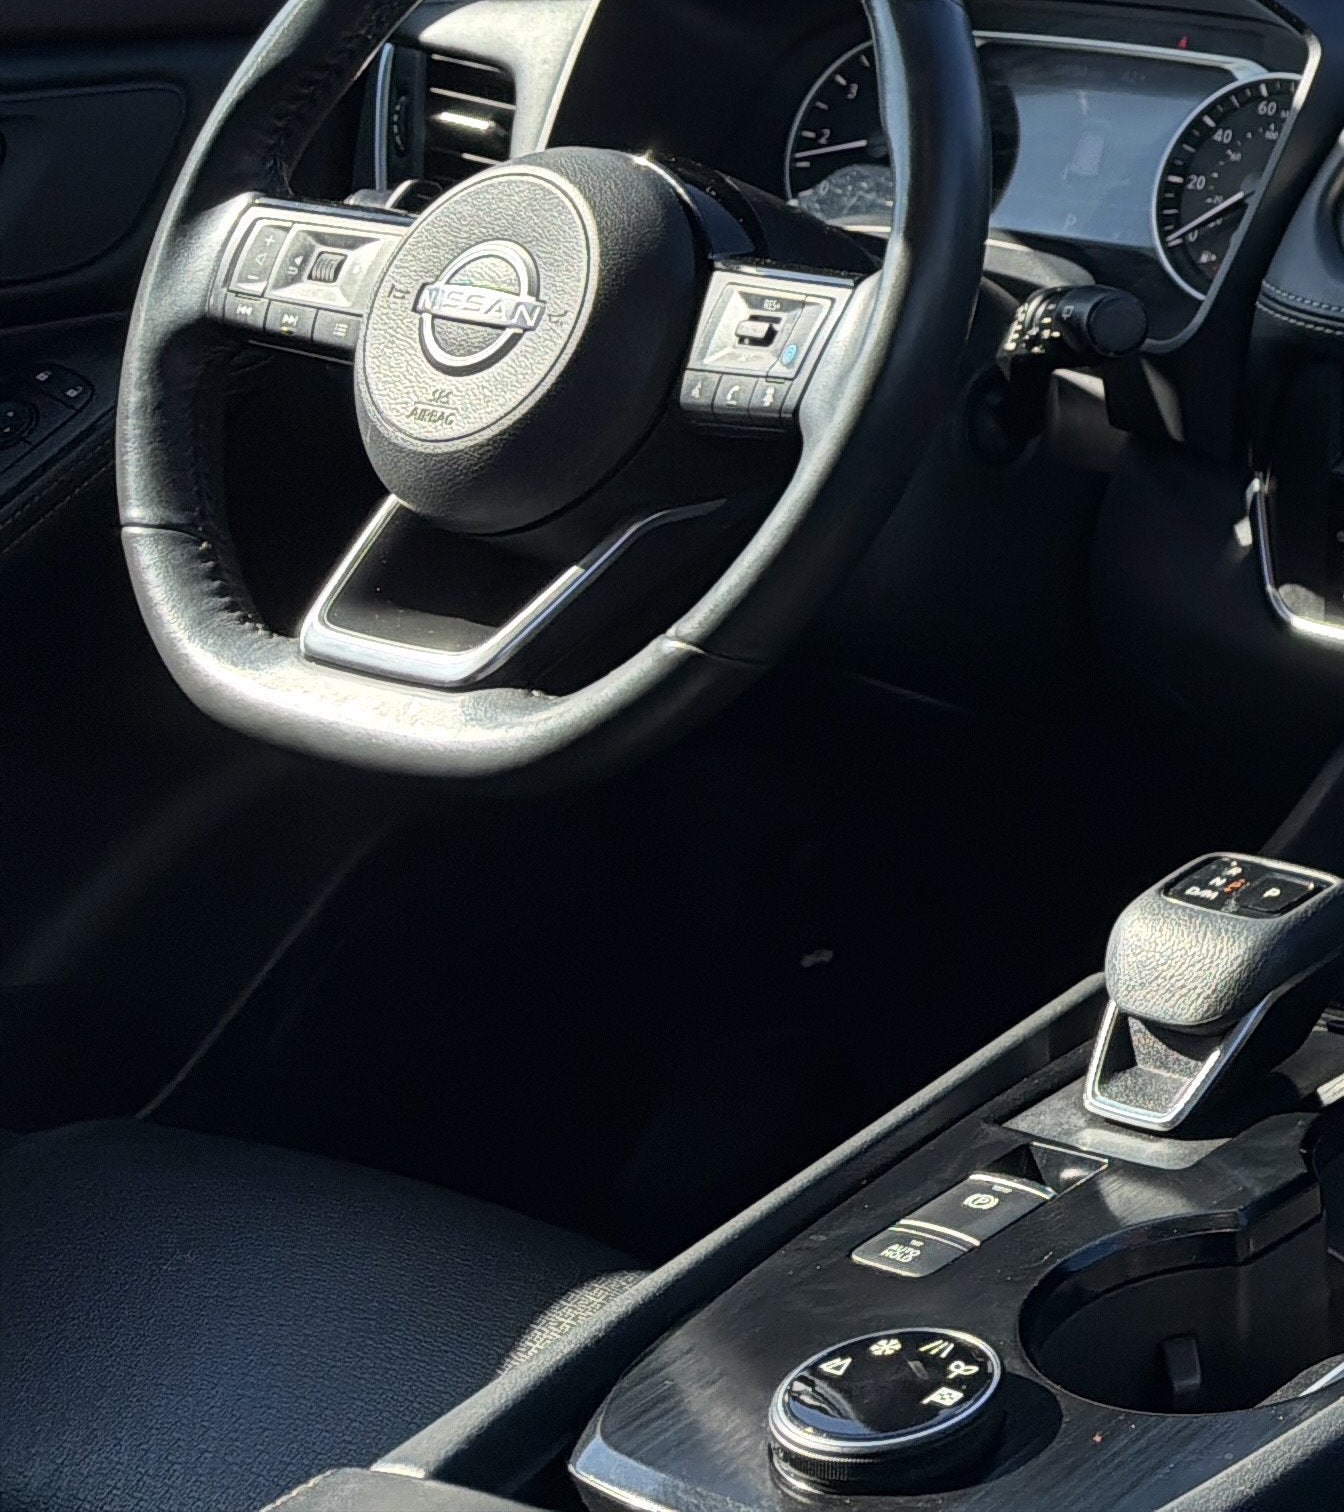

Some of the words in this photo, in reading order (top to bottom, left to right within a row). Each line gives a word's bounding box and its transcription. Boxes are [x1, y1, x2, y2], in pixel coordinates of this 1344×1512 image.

[1258, 100, 1277, 116] 60
[817, 128, 831, 145] 2
[1214, 129, 1233, 144] 40
[1187, 174, 1206, 191] 20
[409, 405, 456, 427] AIRBAG
[1262, 887, 1281, 899] P
[880, 1249, 914, 1264] HOLD
[889, 1243, 922, 1257] AUTO
